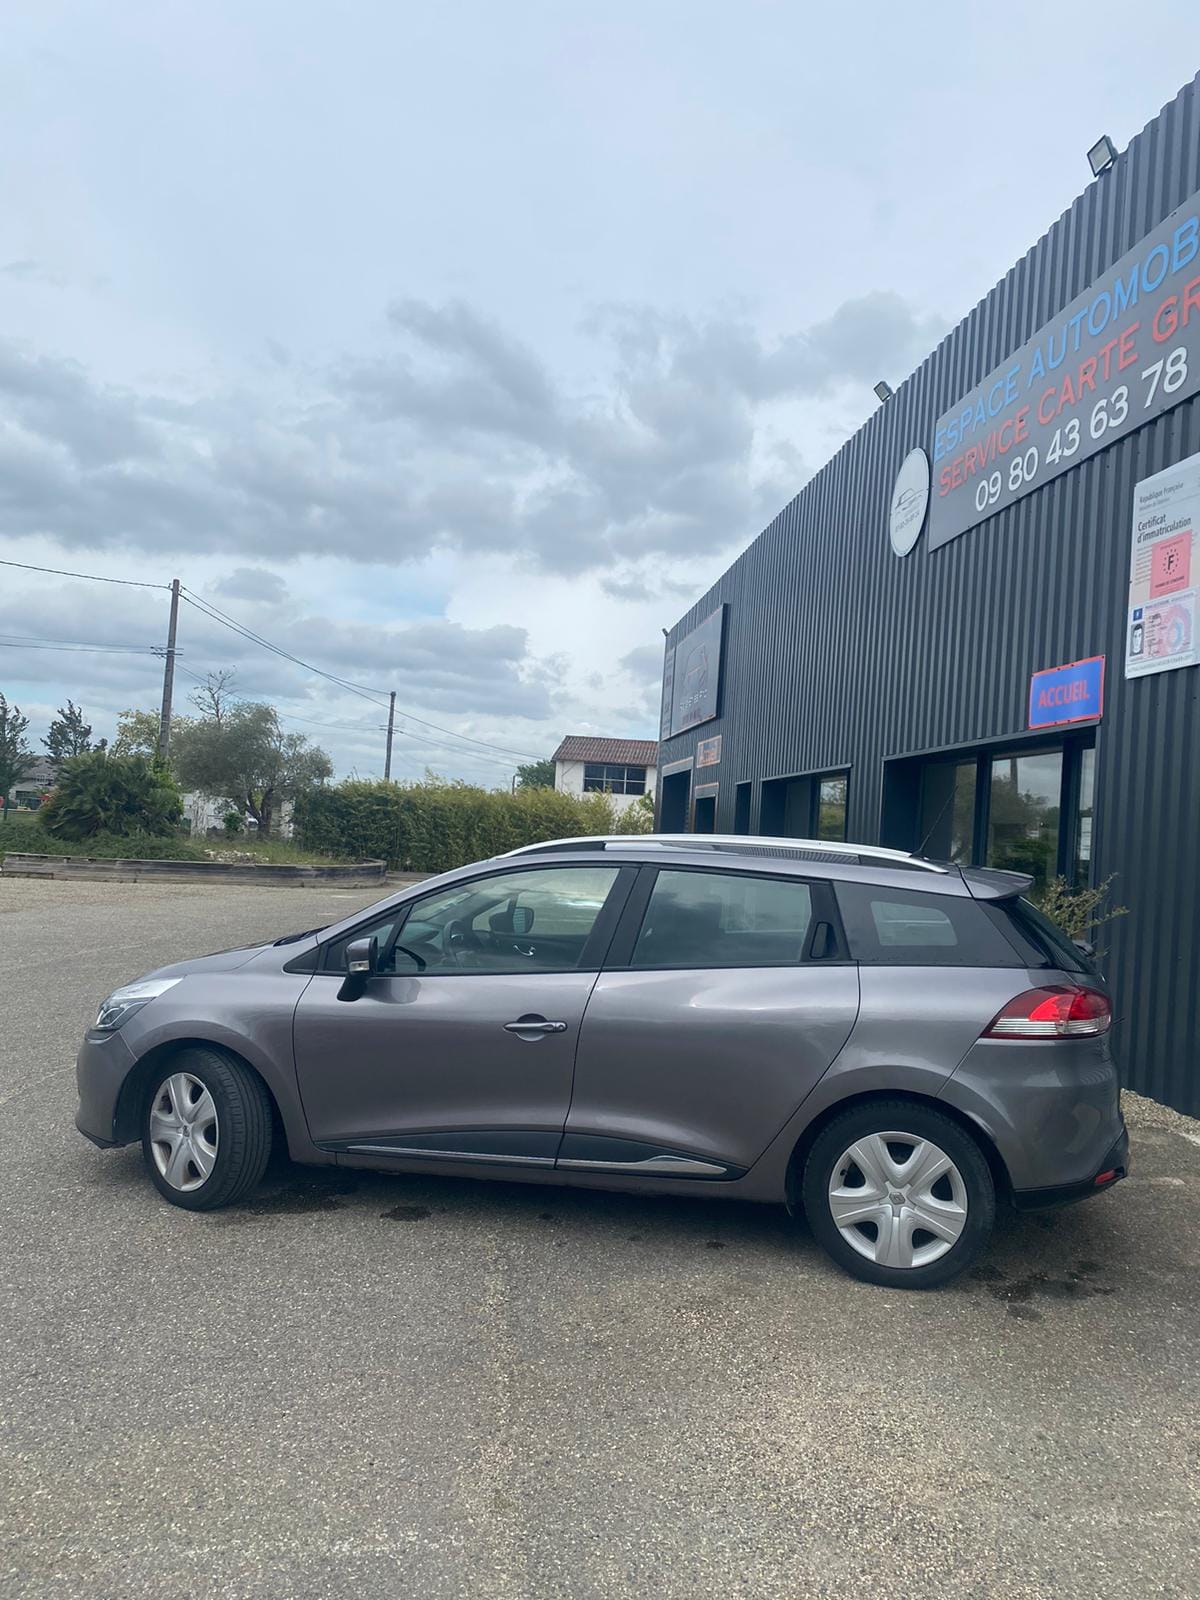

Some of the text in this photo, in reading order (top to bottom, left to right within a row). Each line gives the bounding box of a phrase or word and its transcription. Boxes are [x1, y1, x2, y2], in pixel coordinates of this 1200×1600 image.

[933, 363, 1021, 464] ESPACE
[939, 404, 1030, 498] SERVICE
[1036, 320, 1140, 425] CARTE
[975, 346, 1188, 512] 09 80 43 63 78
[1136, 517, 1192, 544] d'immatriculation
[1137, 513, 1167, 532] Certificat
[1167, 553, 1175, 571] F
[1037, 679, 1090, 708] ACCUEIL
